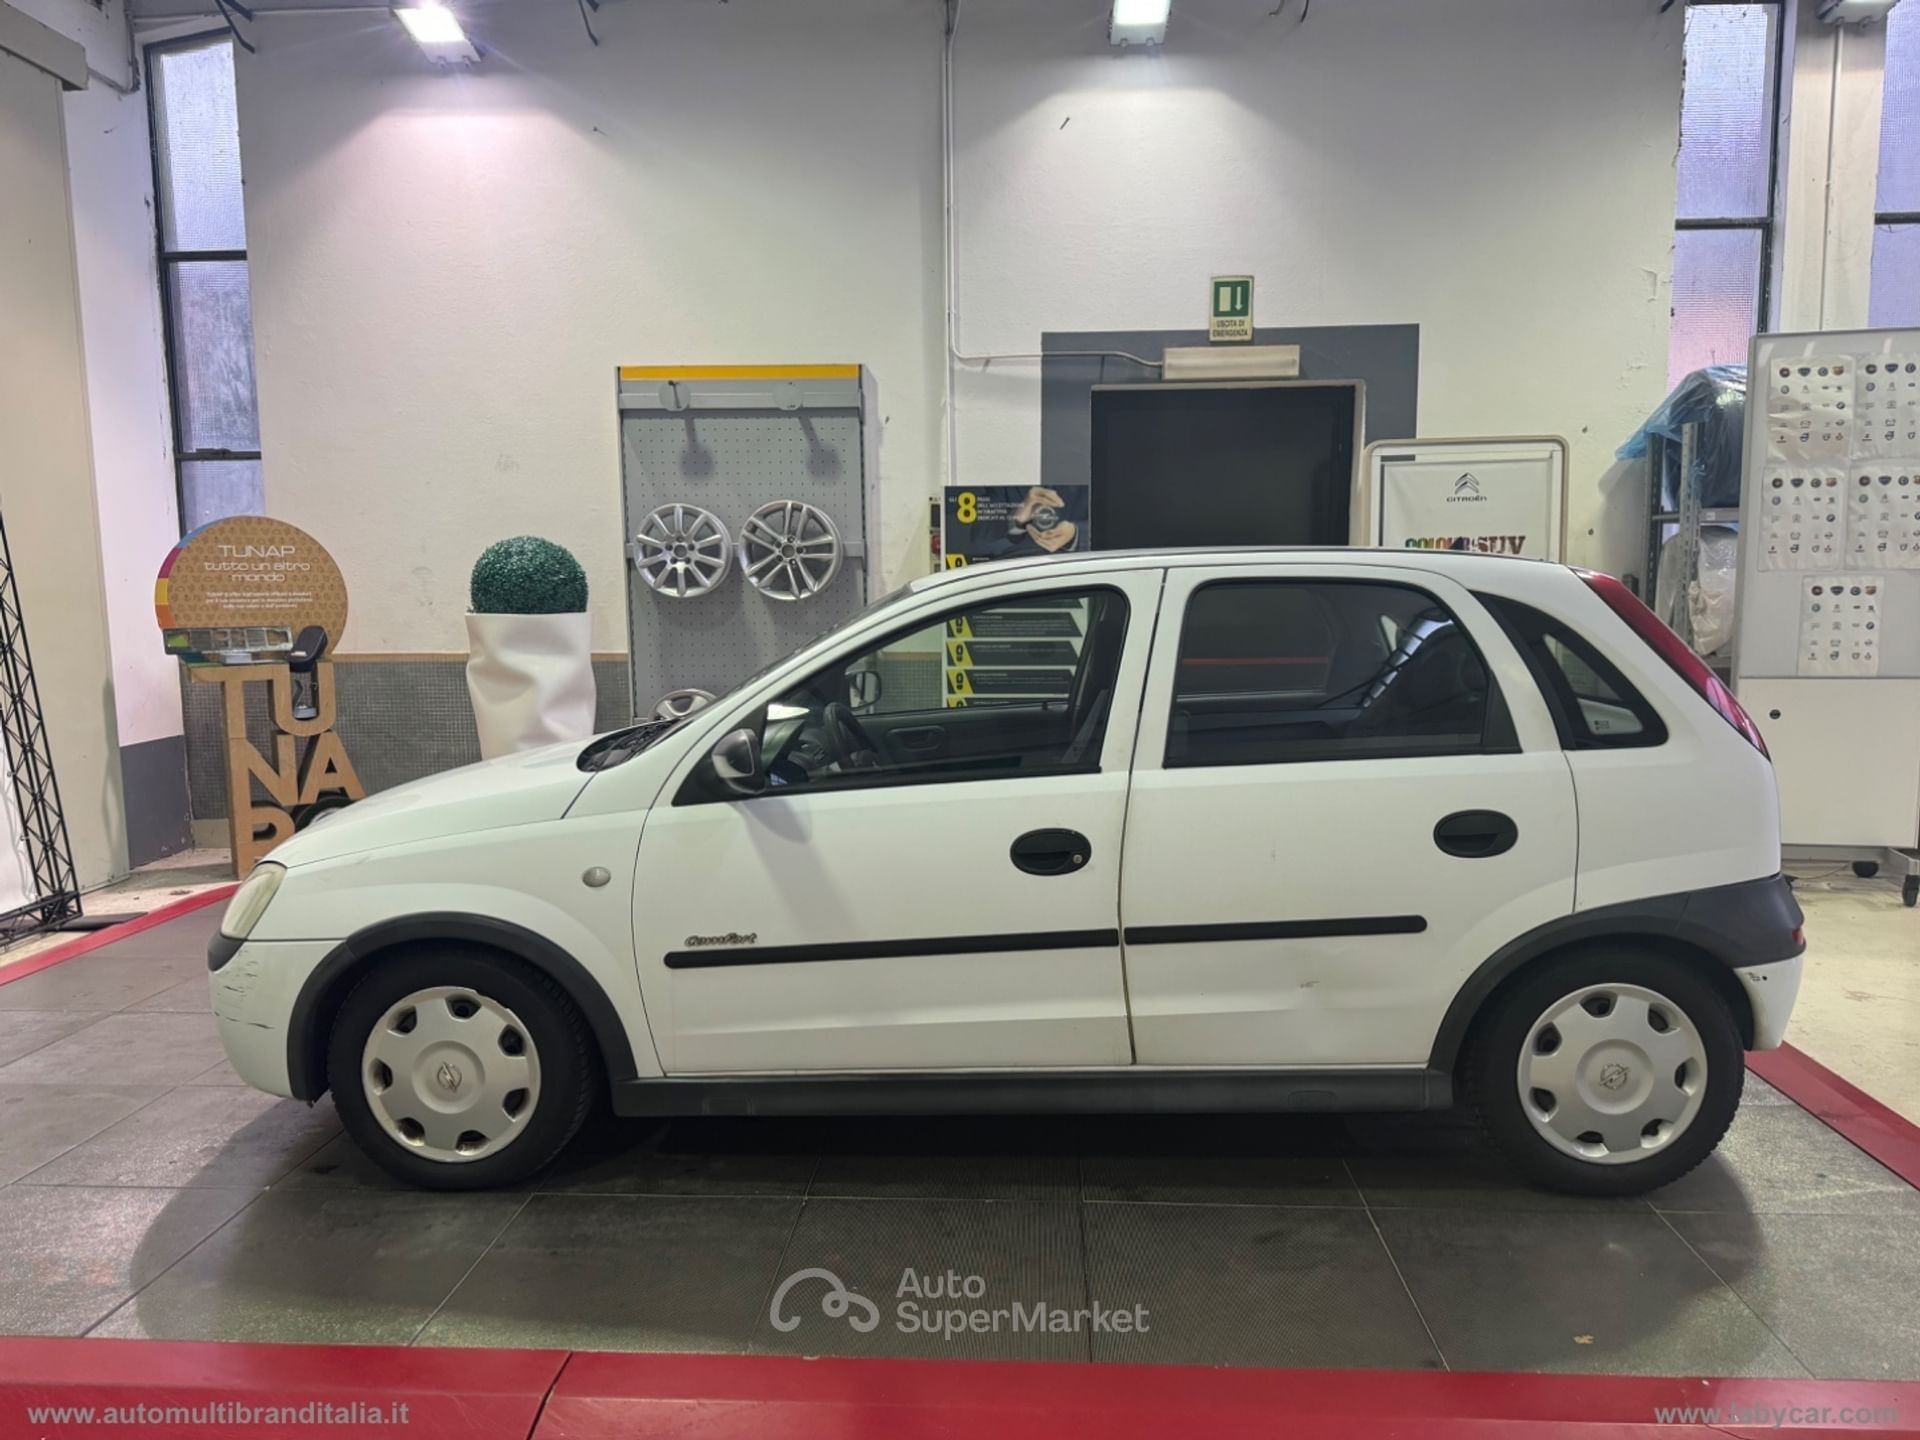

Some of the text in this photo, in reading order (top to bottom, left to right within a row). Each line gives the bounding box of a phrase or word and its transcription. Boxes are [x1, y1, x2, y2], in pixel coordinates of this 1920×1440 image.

[1212, 328, 1248, 337] EMERGENZA
[957, 492, 977, 523] 8
[218, 545, 295, 557] TUNAP
[205, 561, 311, 571] tutto un altro
[231, 573, 285, 582] mondo
[684, 932, 758, 947] Comfort
